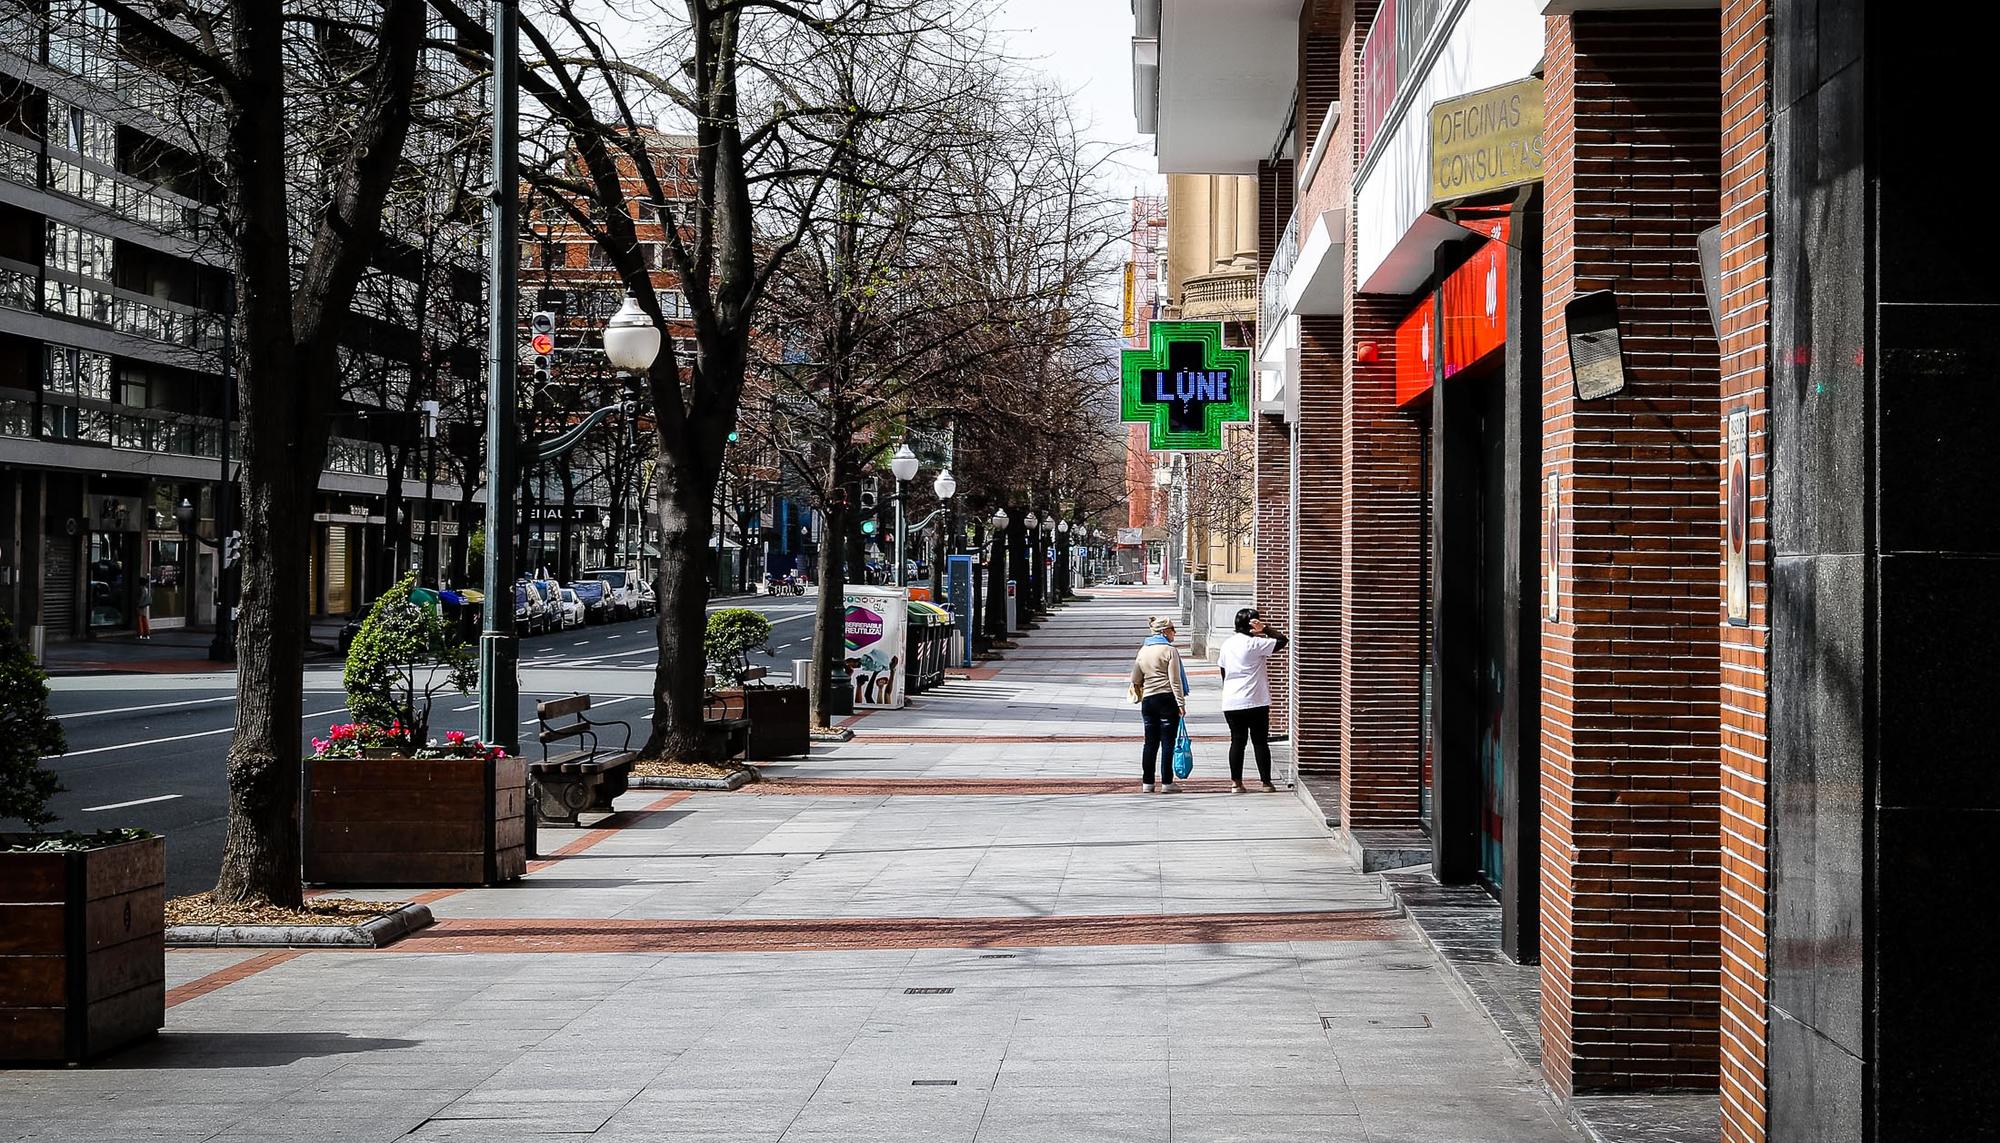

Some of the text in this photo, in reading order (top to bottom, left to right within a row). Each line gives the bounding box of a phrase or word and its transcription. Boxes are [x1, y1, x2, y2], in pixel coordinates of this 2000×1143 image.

[1440, 94, 1521, 145] OFICINAS
[1440, 134, 1544, 190] CONSULTAS
[1156, 371, 1227, 402] LUNE
